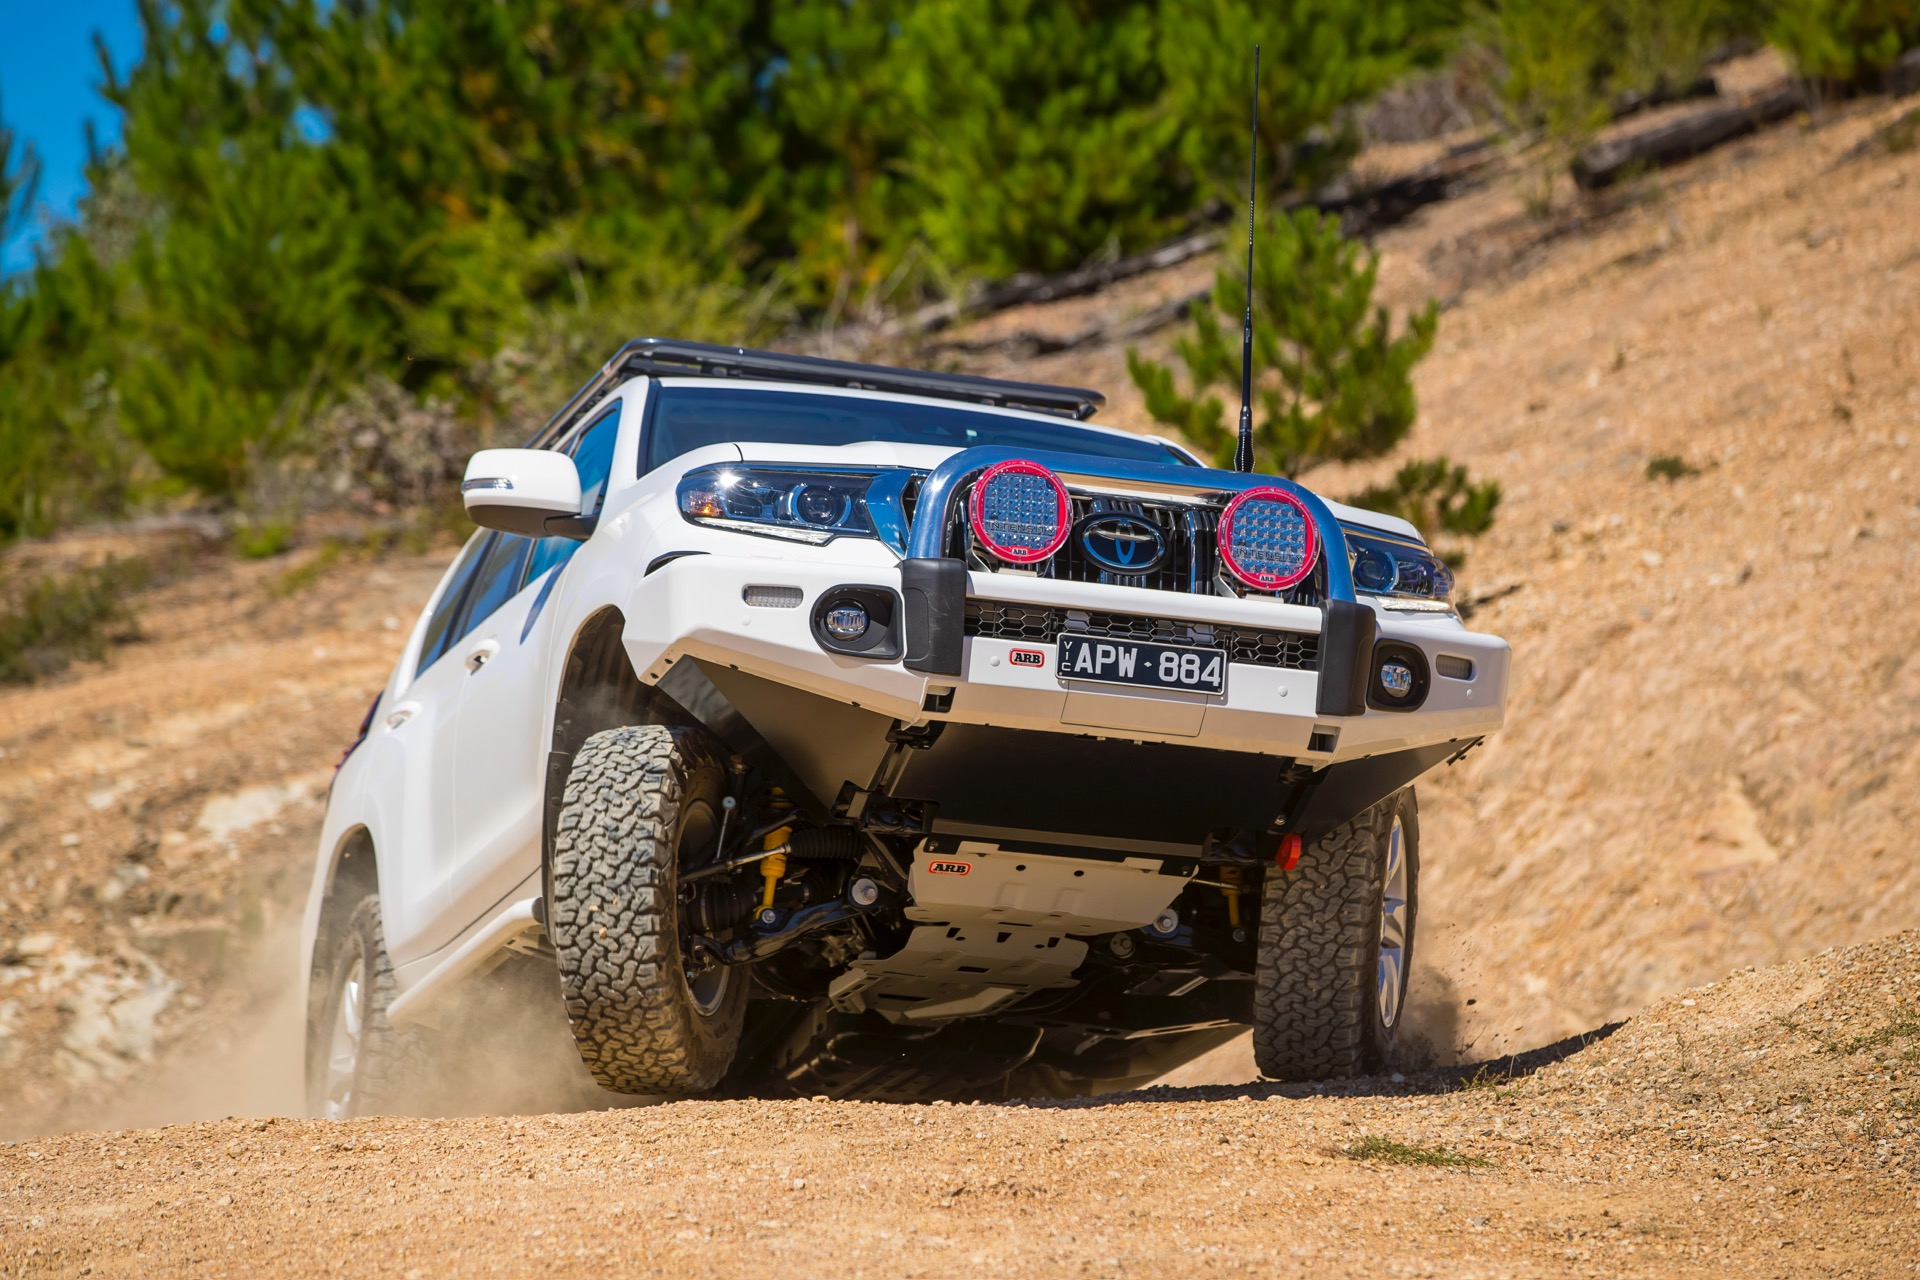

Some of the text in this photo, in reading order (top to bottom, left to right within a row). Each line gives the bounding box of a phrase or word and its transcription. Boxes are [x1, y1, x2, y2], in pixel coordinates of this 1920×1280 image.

[988, 522, 1055, 535] INTENSITY
[1013, 548, 1027, 556] ARB
[1236, 548, 1303, 562] INTENSITY
[1014, 652, 1041, 664] ARB
[1061, 641, 1073, 671] VIC
[1074, 642, 1221, 687] APW 884
[932, 863, 967, 874] ARB
